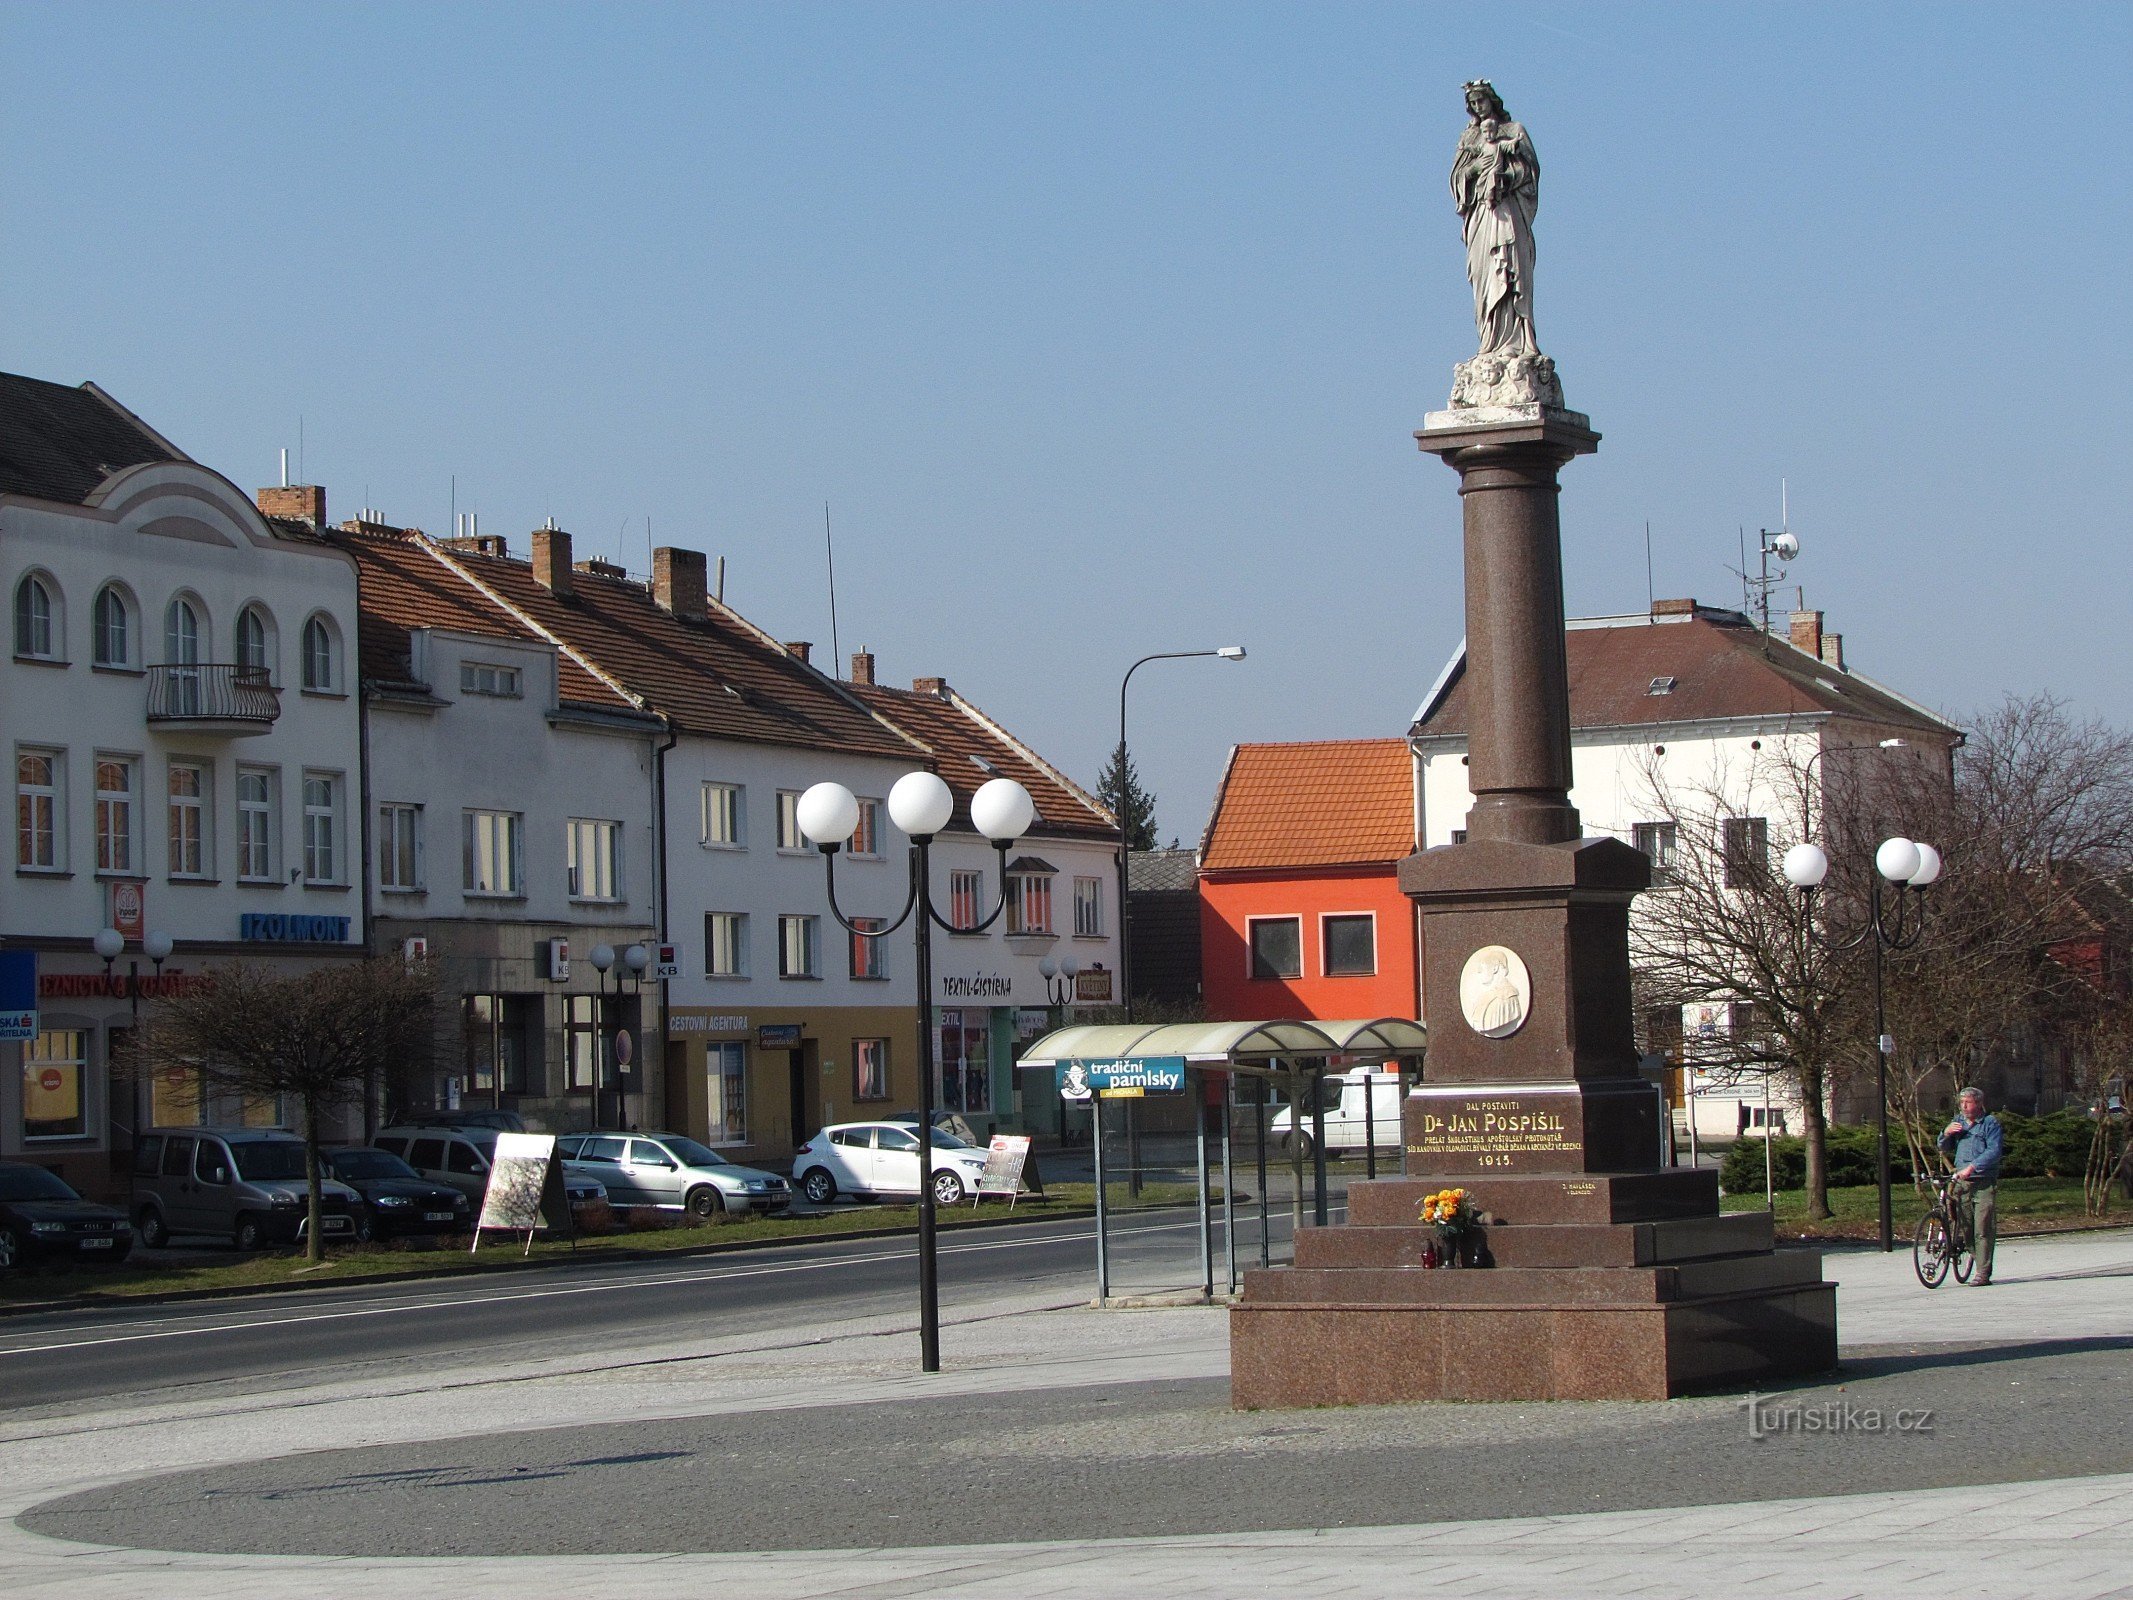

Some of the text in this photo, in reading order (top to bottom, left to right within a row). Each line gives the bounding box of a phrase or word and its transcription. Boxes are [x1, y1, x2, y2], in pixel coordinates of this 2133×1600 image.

[241, 913, 352, 941] IZOLMONT
[656, 966, 678, 976] KB
[943, 970, 1012, 998] TEXTIL-ČISTÍRNA
[670, 1013, 749, 1032] CESTOVNÍ AGENTURA
[1090, 1059, 1144, 1075] tradiční
[1109, 1069, 1180, 1091] pamlsky
[1466, 1101, 1520, 1111] DAL POSTAVITI
[1448, 1114, 1478, 1132] JAN
[1484, 1111, 1565, 1132] POSPÍŠIL
